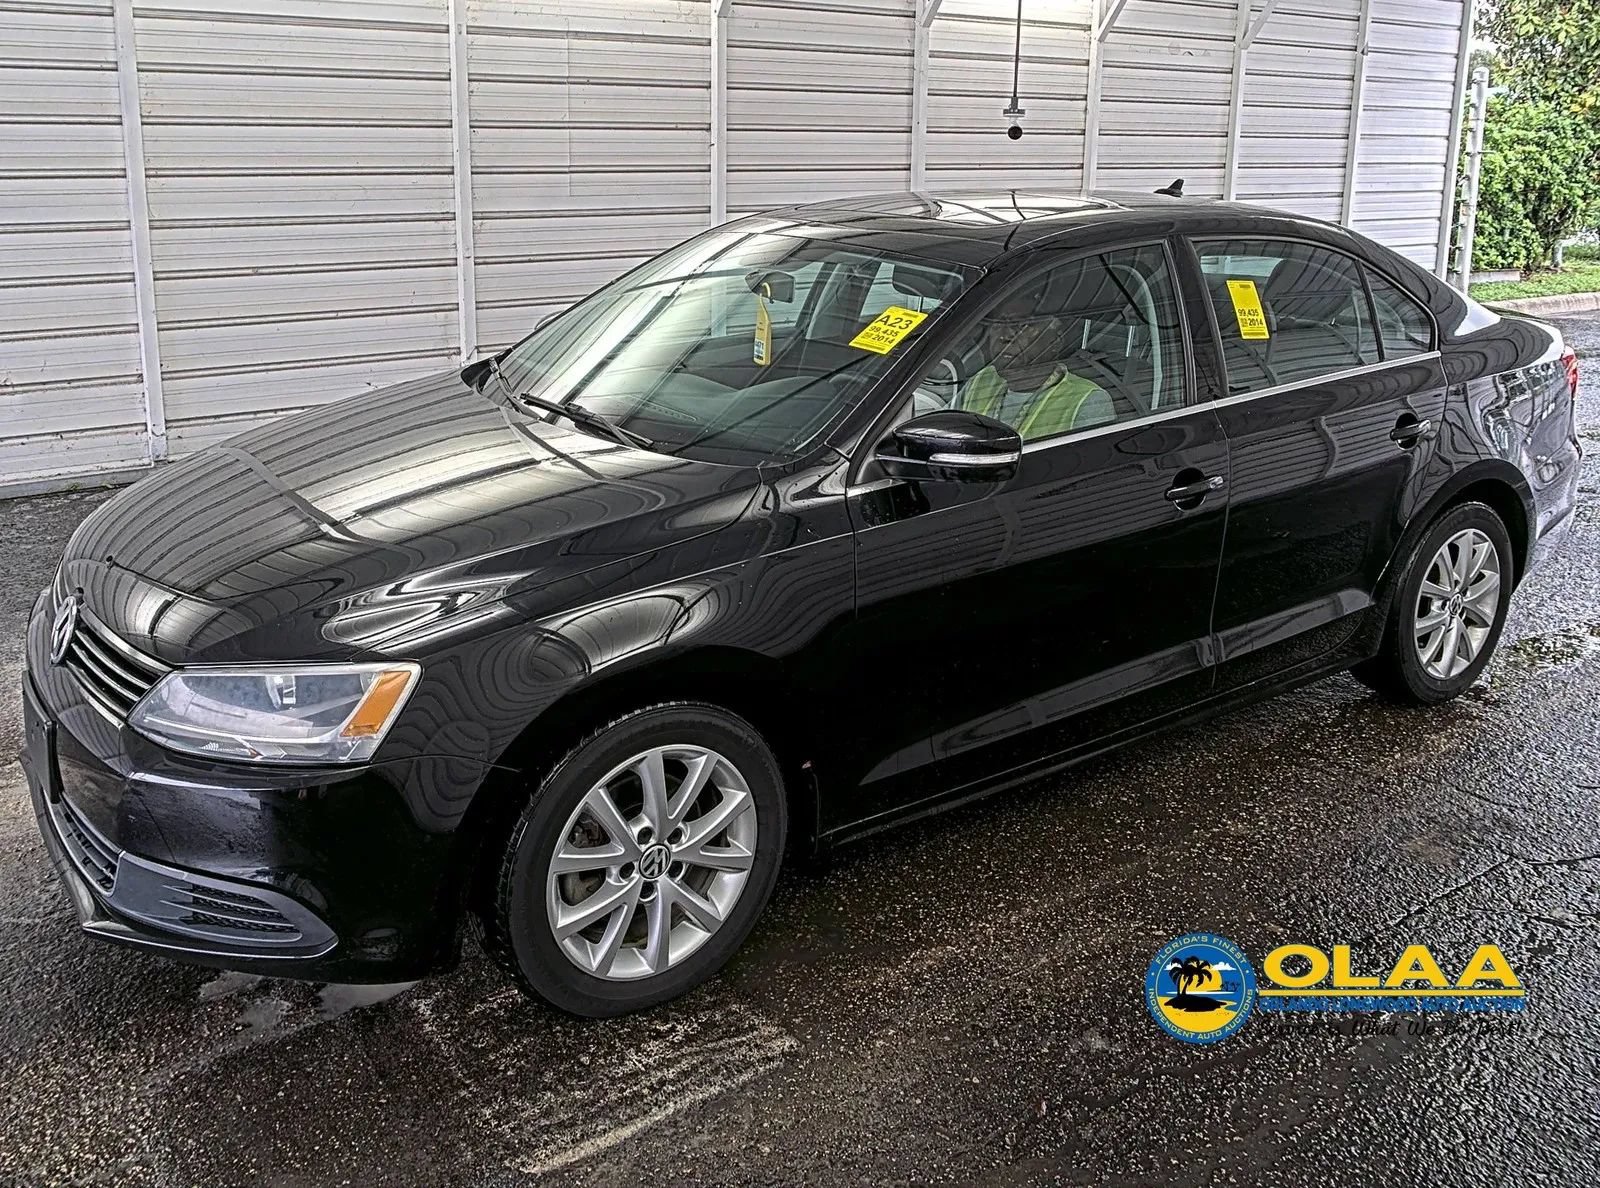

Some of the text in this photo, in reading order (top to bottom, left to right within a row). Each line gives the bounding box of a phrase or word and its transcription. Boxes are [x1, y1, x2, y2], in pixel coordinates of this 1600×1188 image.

[1238, 308, 1259, 317] 99,435
[875, 314, 913, 330] A23
[1248, 318, 1264, 327] 2014
[868, 325, 900, 338] 99,435
[872, 333, 896, 345] 2014
